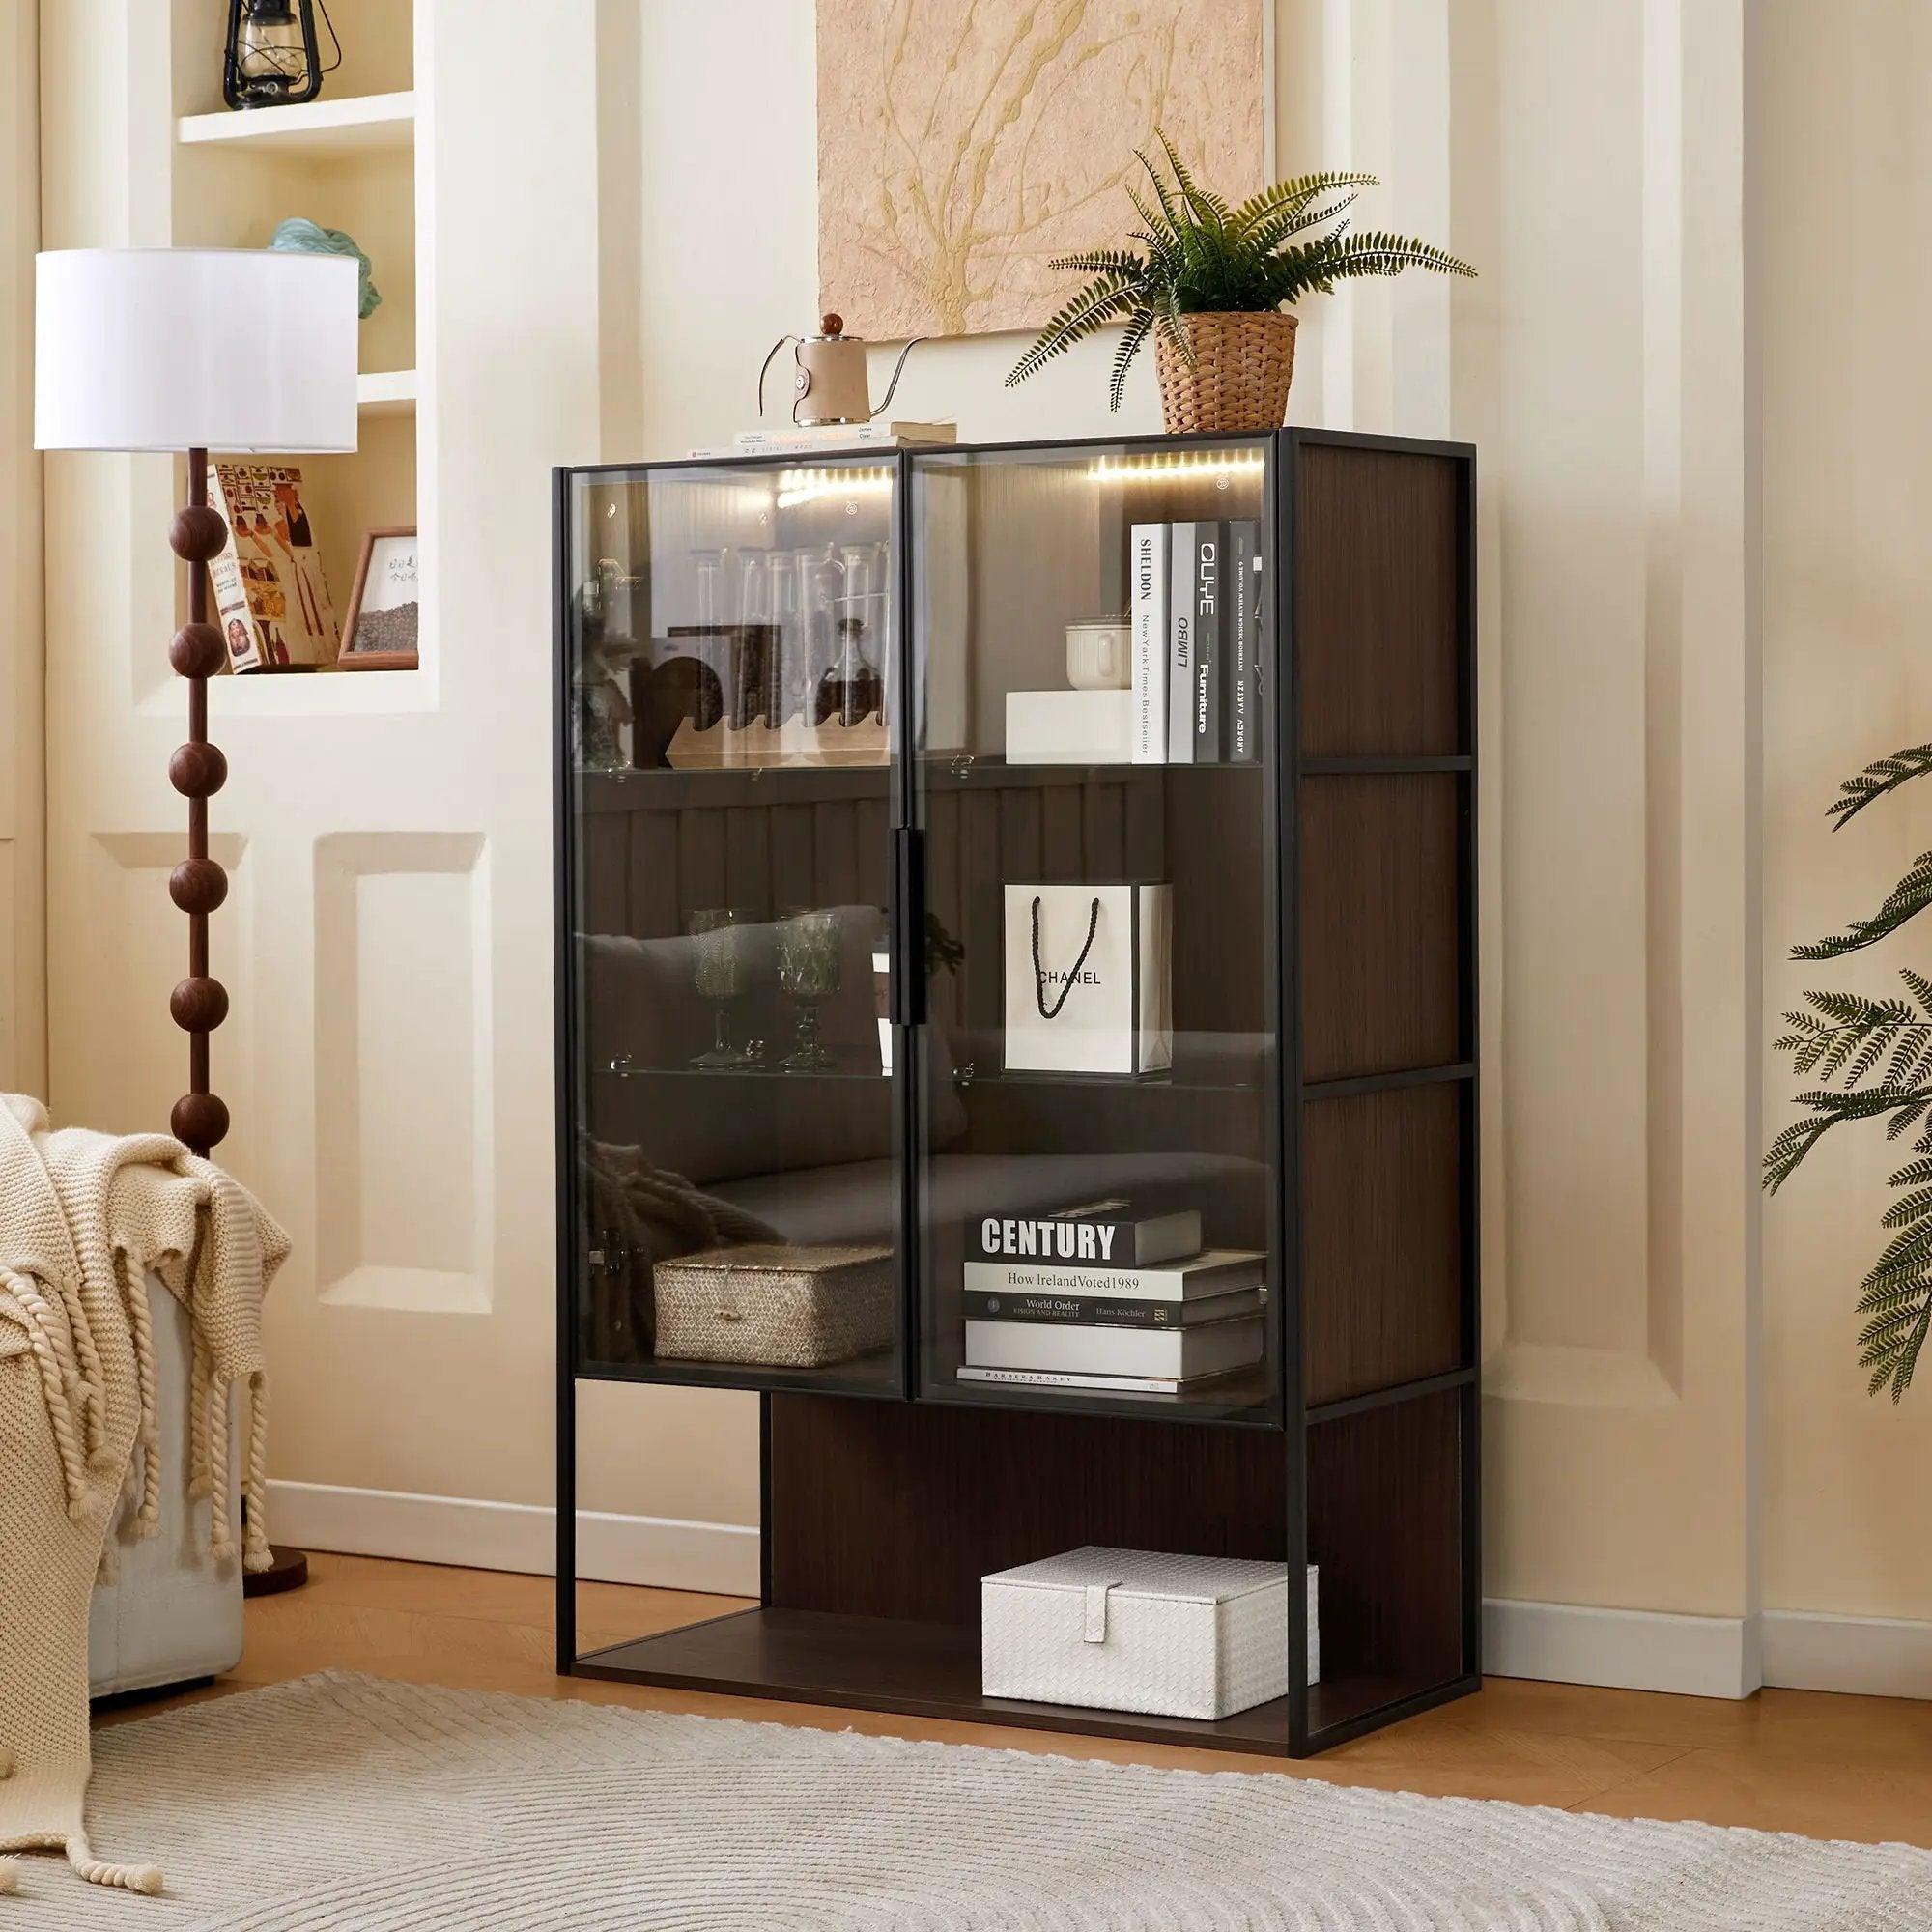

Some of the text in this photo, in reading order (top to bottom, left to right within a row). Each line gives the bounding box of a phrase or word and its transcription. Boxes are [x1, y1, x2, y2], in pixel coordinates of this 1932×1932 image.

[1140, 539, 1151, 600] SHELDON
[1177, 616, 1189, 668] LIMBO
[1198, 664, 1209, 734] Furniture
[1038, 971, 1101, 984] CHANEL
[981, 1217, 1116, 1261] CENTURY
[1008, 1272, 1035, 1285] How
[1026, 1299, 1080, 1311] World Order
